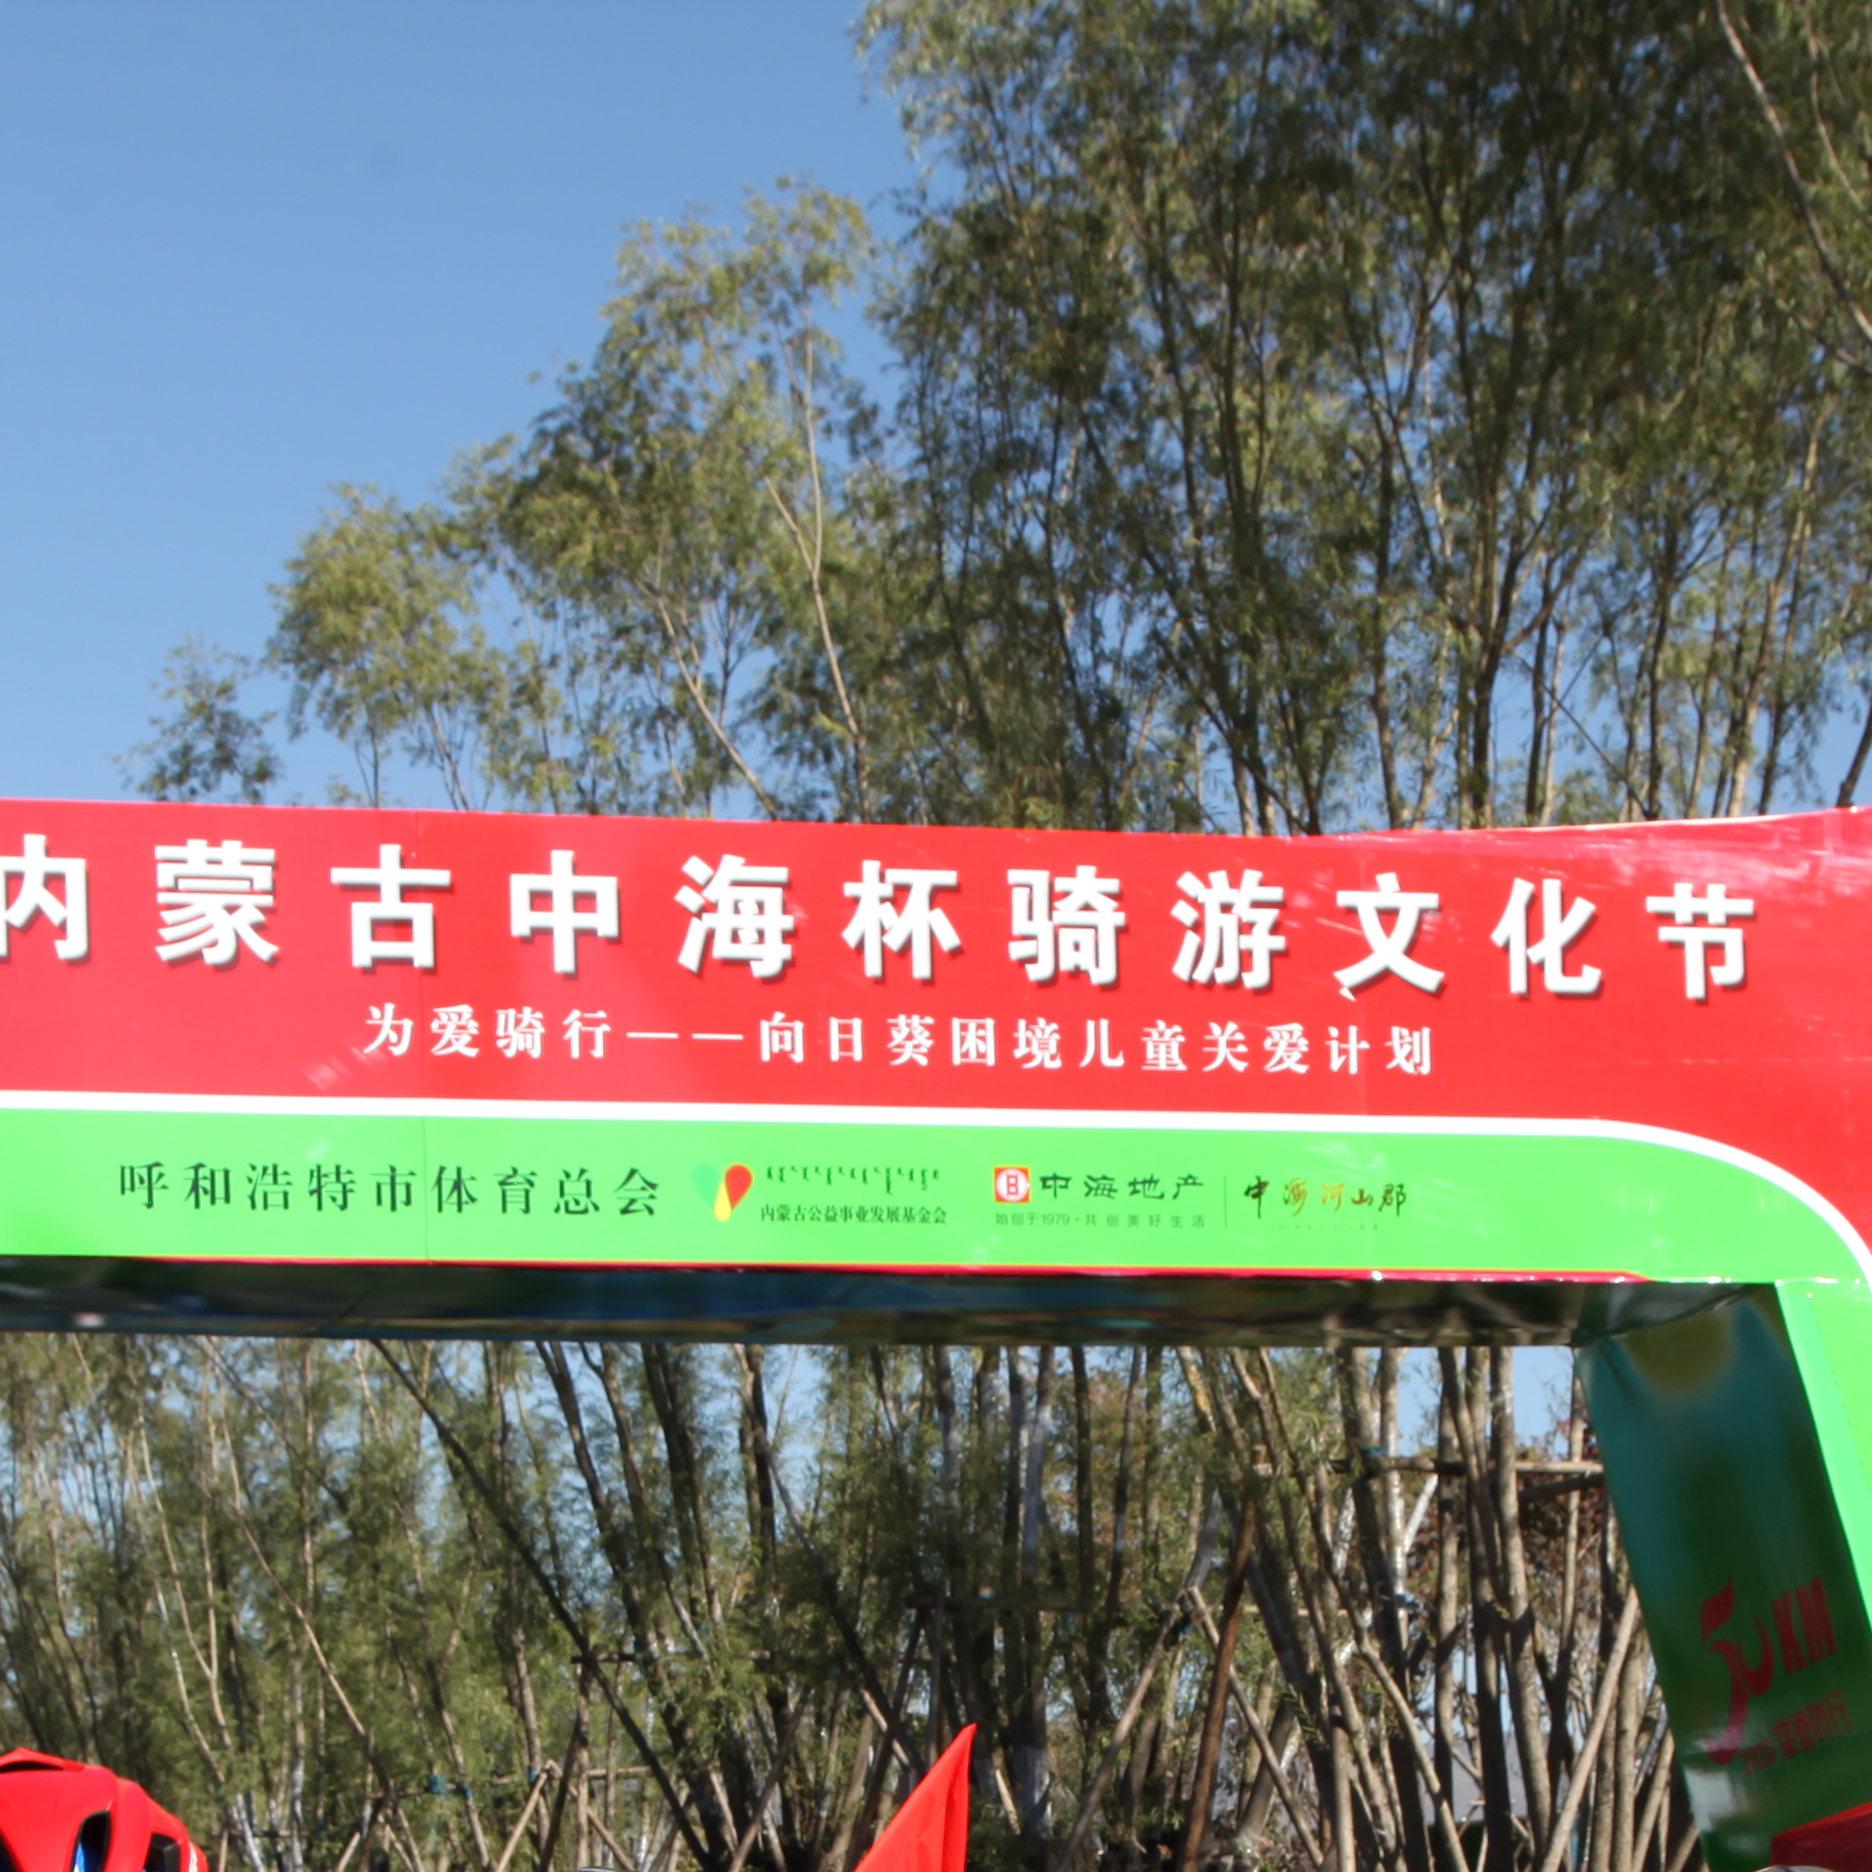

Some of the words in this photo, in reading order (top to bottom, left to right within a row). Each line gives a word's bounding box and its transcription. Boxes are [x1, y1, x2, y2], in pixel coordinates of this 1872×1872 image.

[363, 1002, 1434, 1078] 为爱骑行——向日葵困境儿童关爱计划
[118, 1160, 661, 1217] 呼和浩特市体育总会
[761, 1203, 947, 1225] 内蒙古公益事业发展基金会
[1039, 1173, 1204, 1200] 中海地产
[1774, 1691, 1854, 1759] 荣誉骑行
